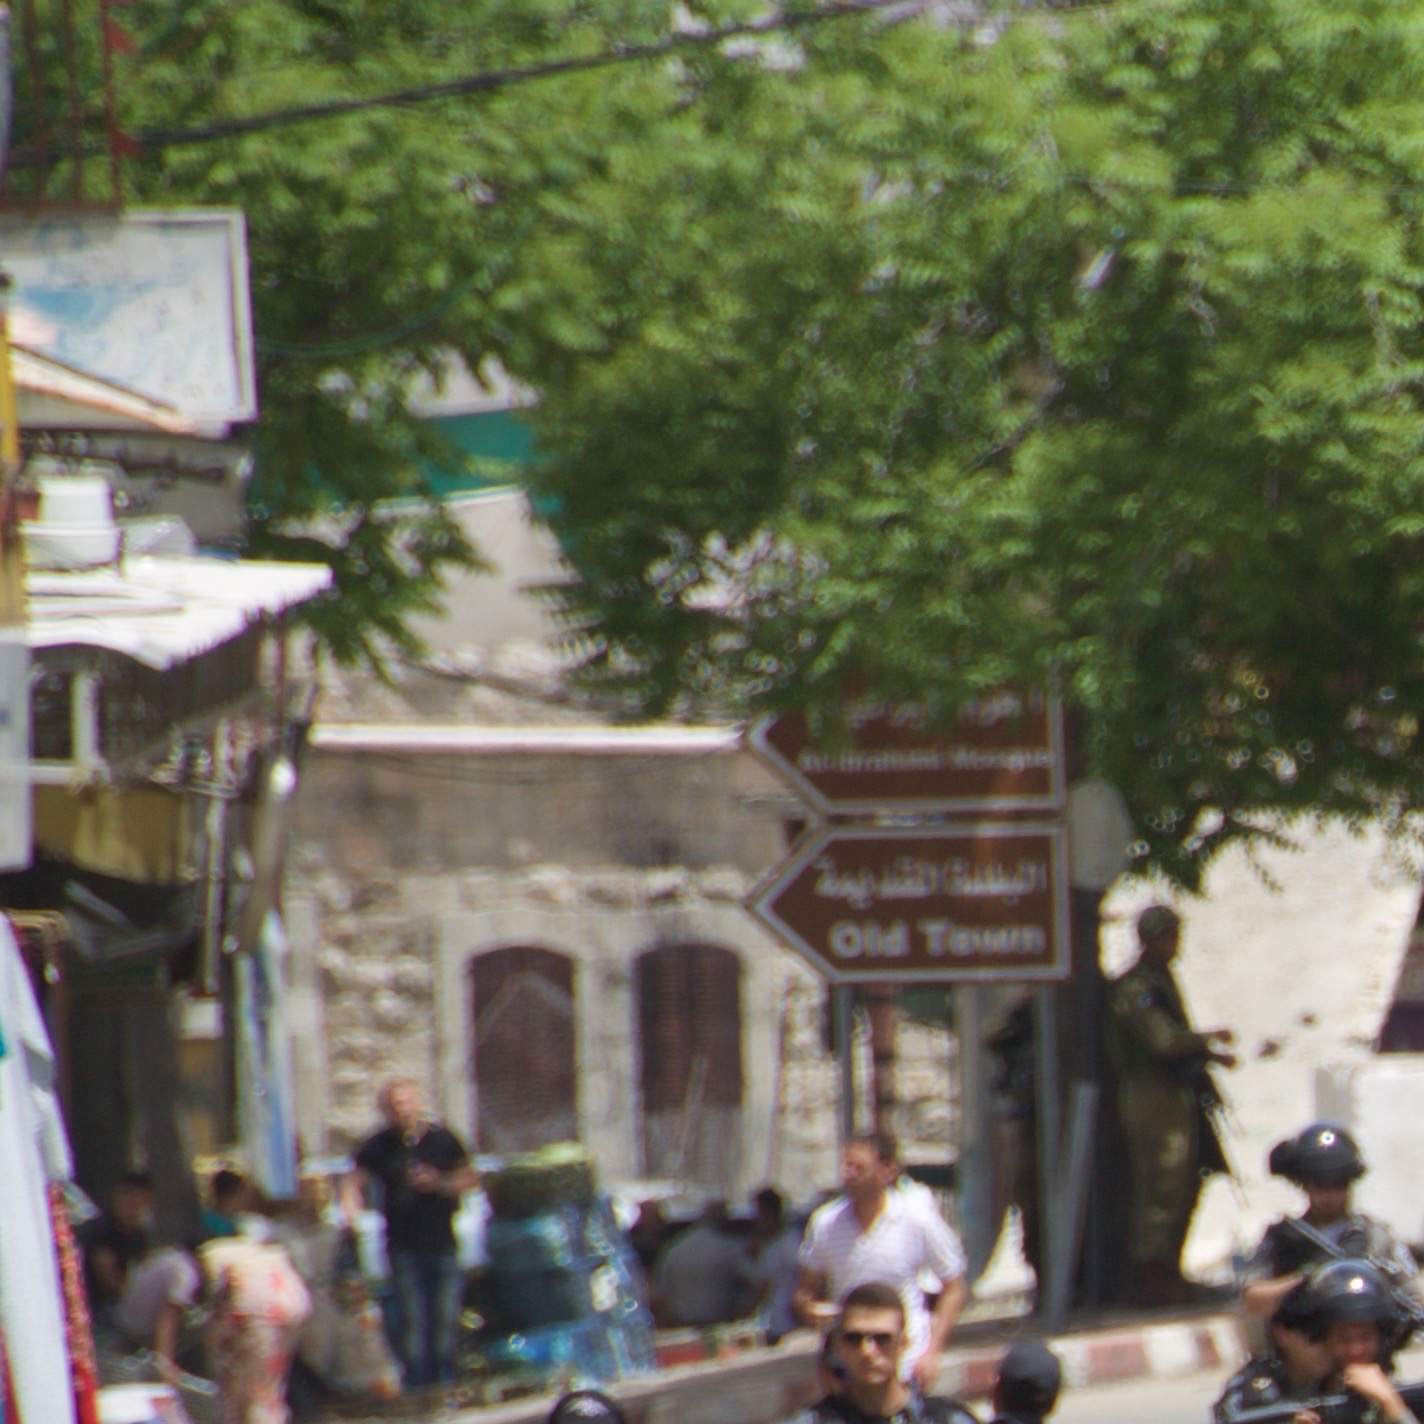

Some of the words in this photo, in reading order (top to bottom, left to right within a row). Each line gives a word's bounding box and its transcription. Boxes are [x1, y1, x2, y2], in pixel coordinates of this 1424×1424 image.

[814, 856, 945, 911] القديمة
[829, 919, 911, 960] Old
[917, 917, 1048, 957] Town
